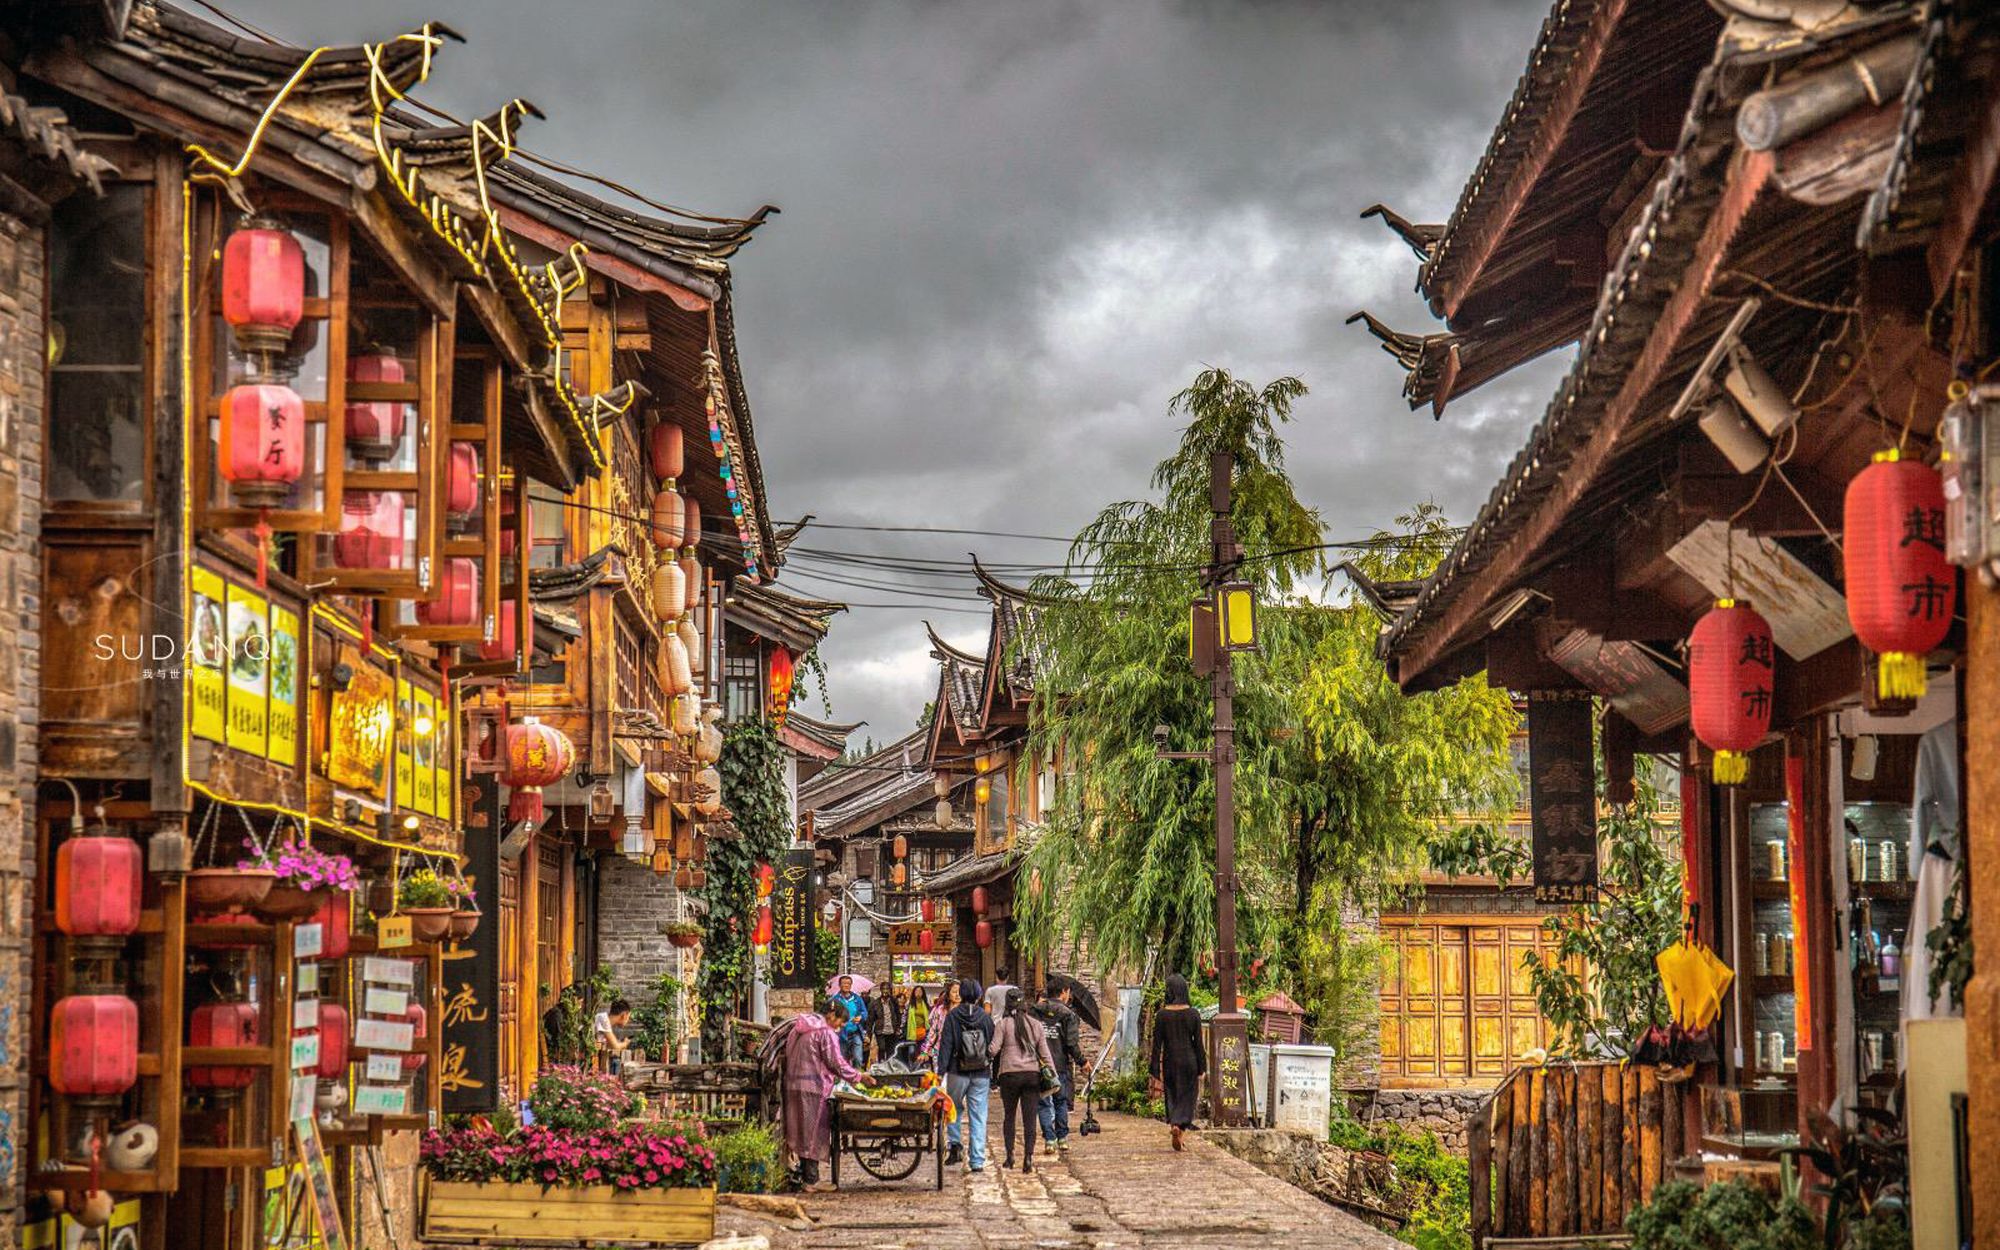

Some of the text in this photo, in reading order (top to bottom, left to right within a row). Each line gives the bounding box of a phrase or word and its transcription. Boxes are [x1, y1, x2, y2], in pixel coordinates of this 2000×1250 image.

[1900, 504, 1950, 621] 超市
[1739, 634, 1773, 720] 超市
[780, 886, 800, 976] Compass
[894, 928, 953, 946] 纳手
